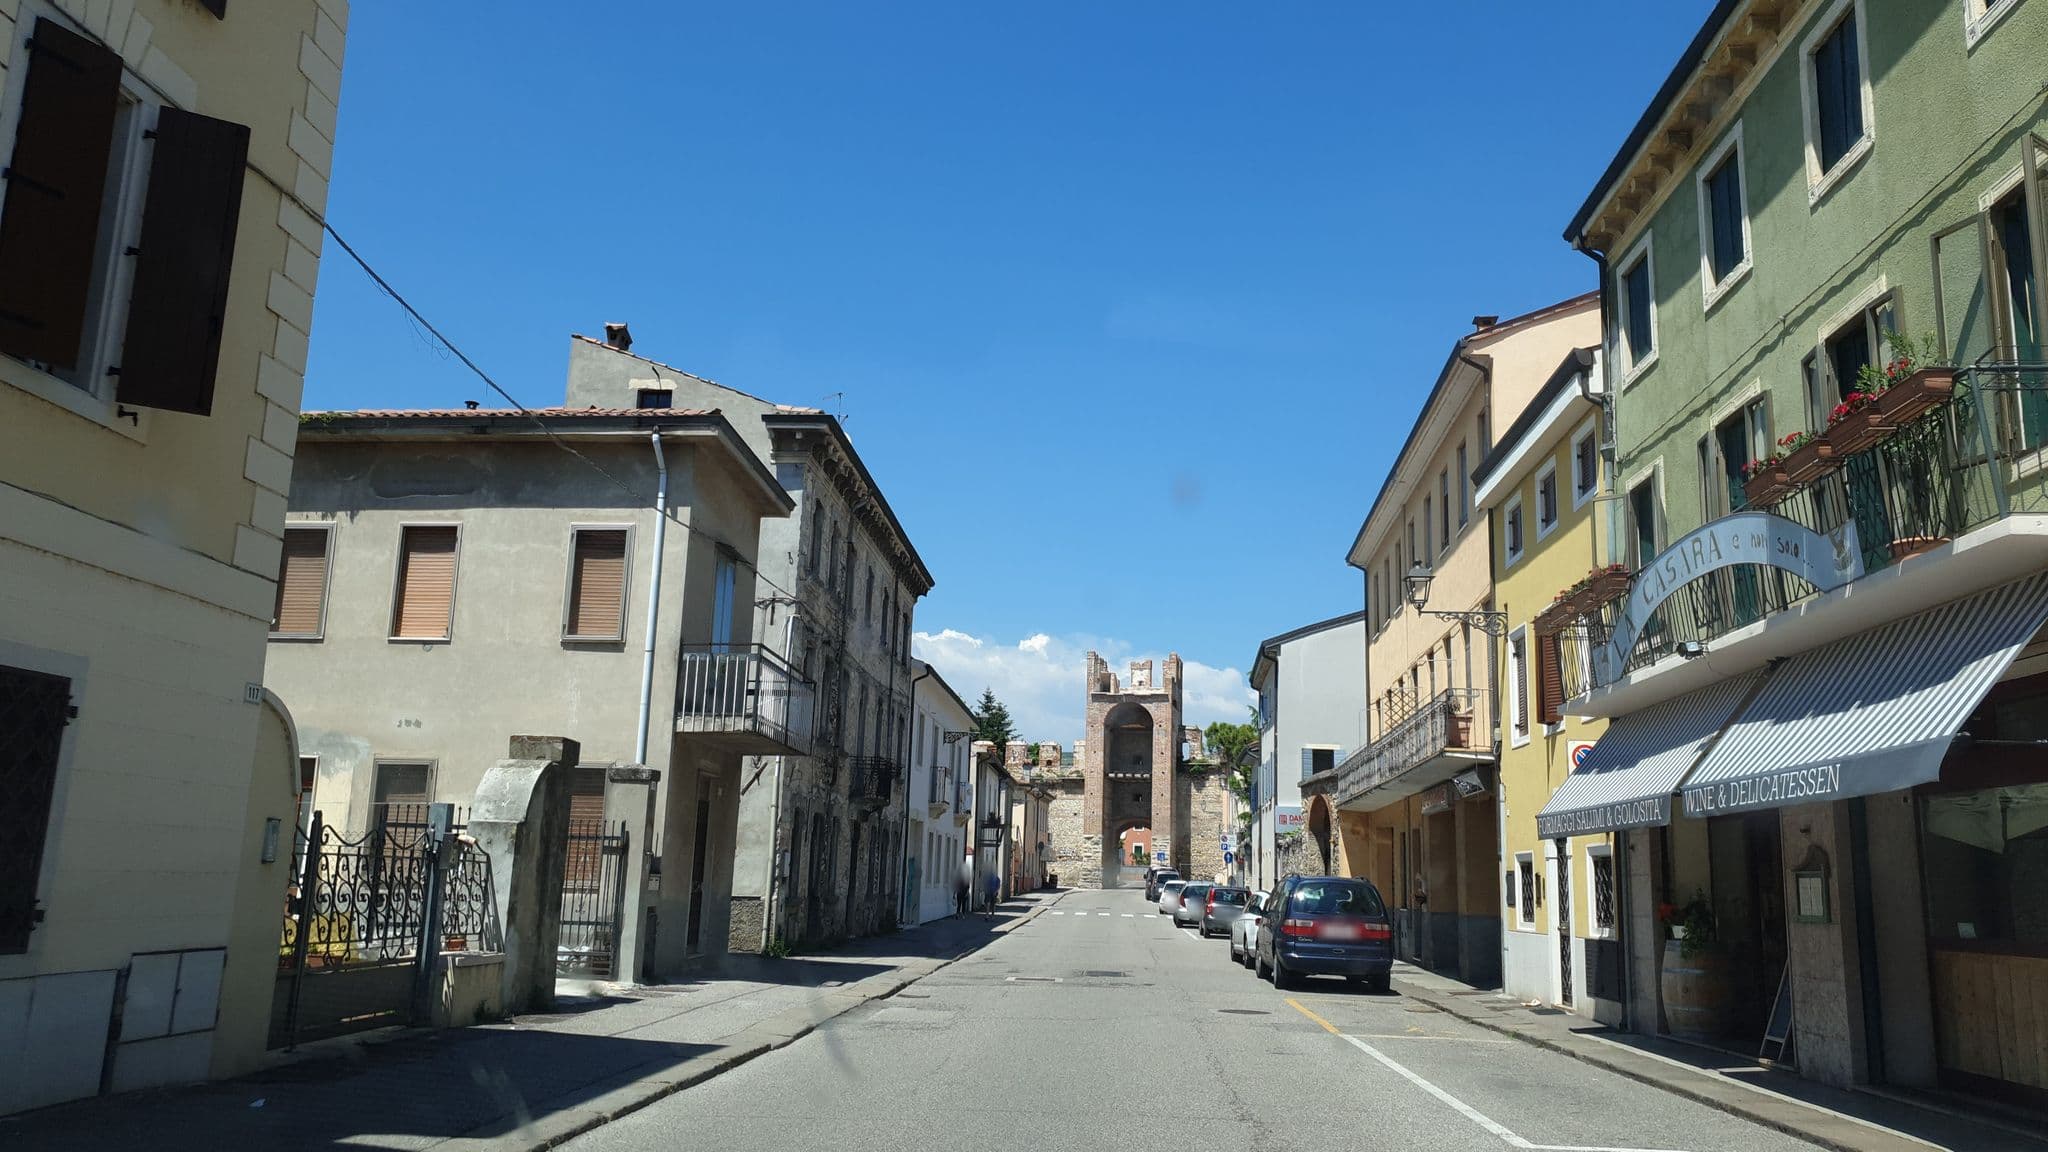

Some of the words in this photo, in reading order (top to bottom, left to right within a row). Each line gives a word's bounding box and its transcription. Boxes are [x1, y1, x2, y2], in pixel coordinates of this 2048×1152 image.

[1614, 615, 1636, 662] LA
[249, 686, 260, 700] 117
[1684, 785, 1715, 813] WINE
[1718, 783, 1727, 809] &
[1730, 763, 1841, 807] DELICATESSEN
[1538, 813, 1575, 835] FORMAGGI
[1576, 807, 1605, 830] SALUMI
[1606, 806, 1613, 826] &
